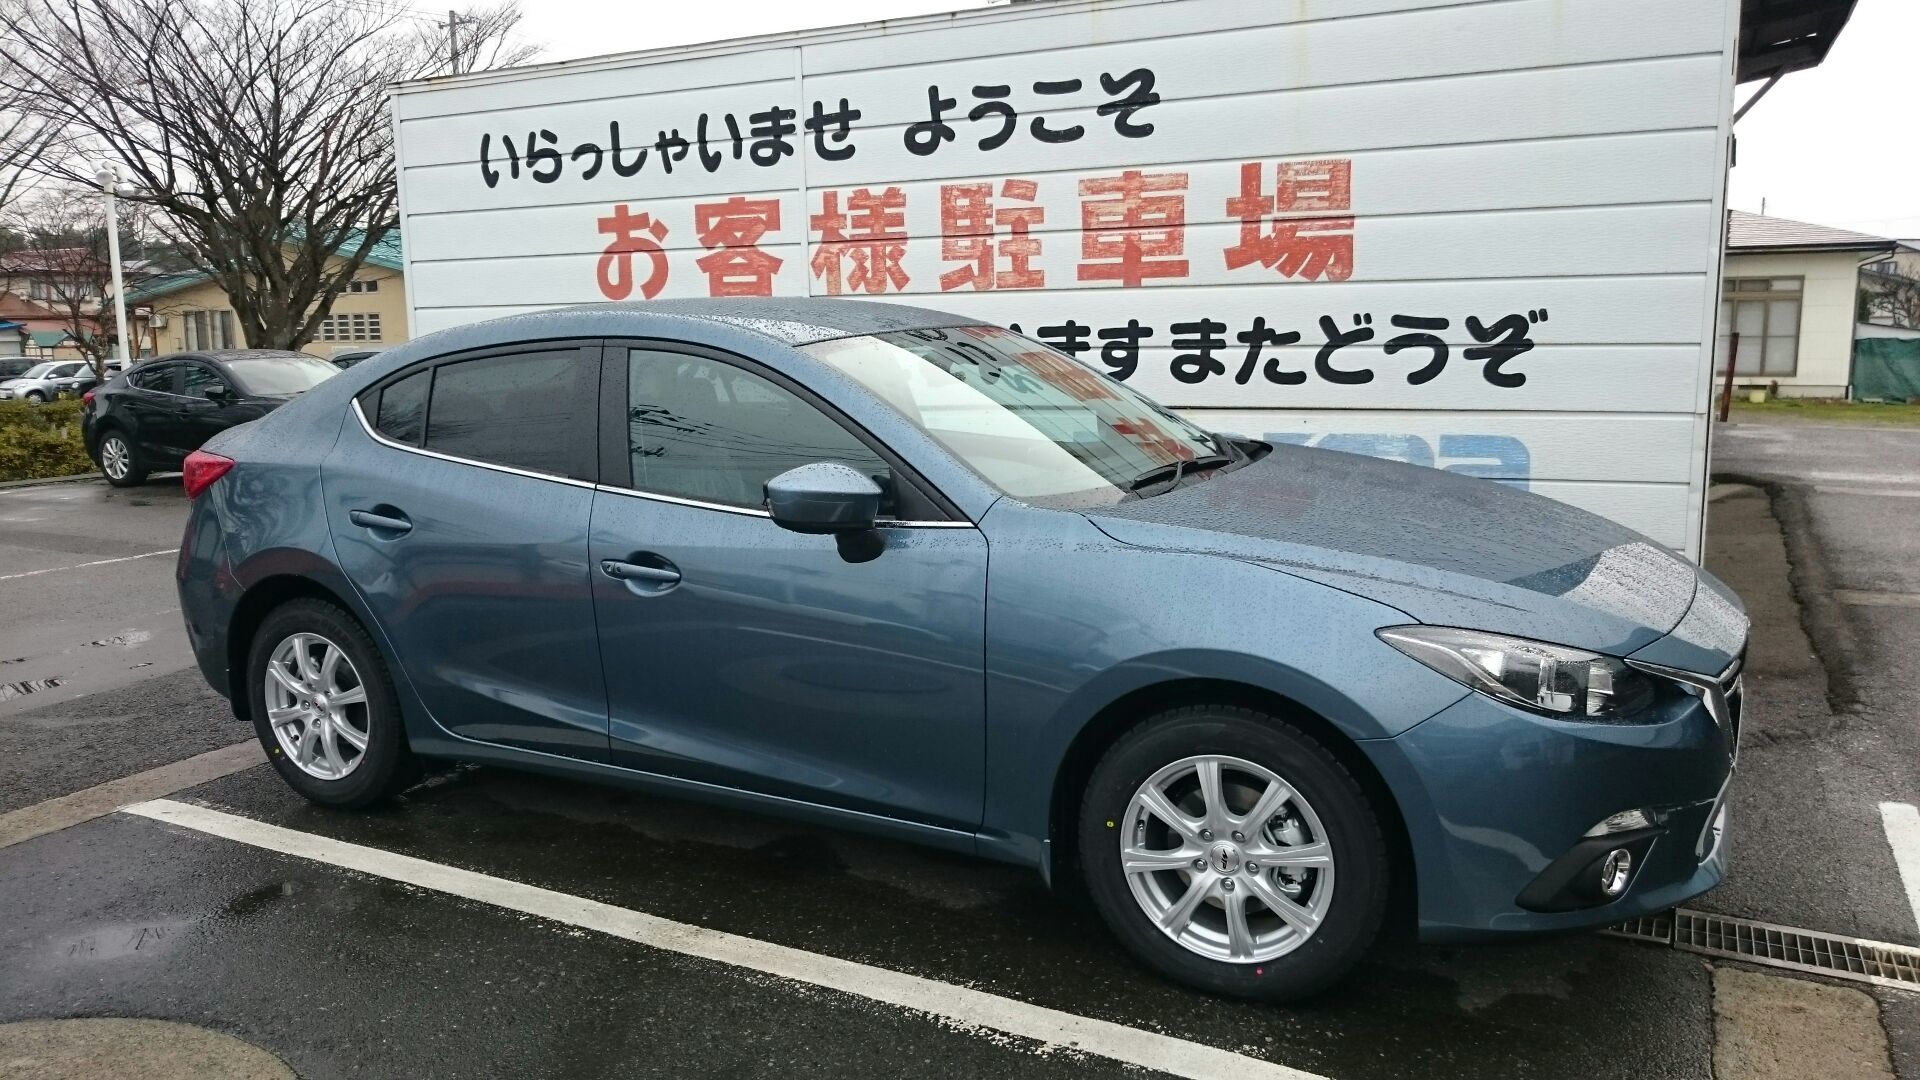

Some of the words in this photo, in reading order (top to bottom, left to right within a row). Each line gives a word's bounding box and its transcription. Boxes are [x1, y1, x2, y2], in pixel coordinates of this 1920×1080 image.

[480, 97, 862, 189] いらっしゃいませ
[903, 68, 1162, 156] ようこそ
[596, 159, 1356, 301] お客様駐車場
[1009, 308, 1550, 388] ますまたどうぞ
